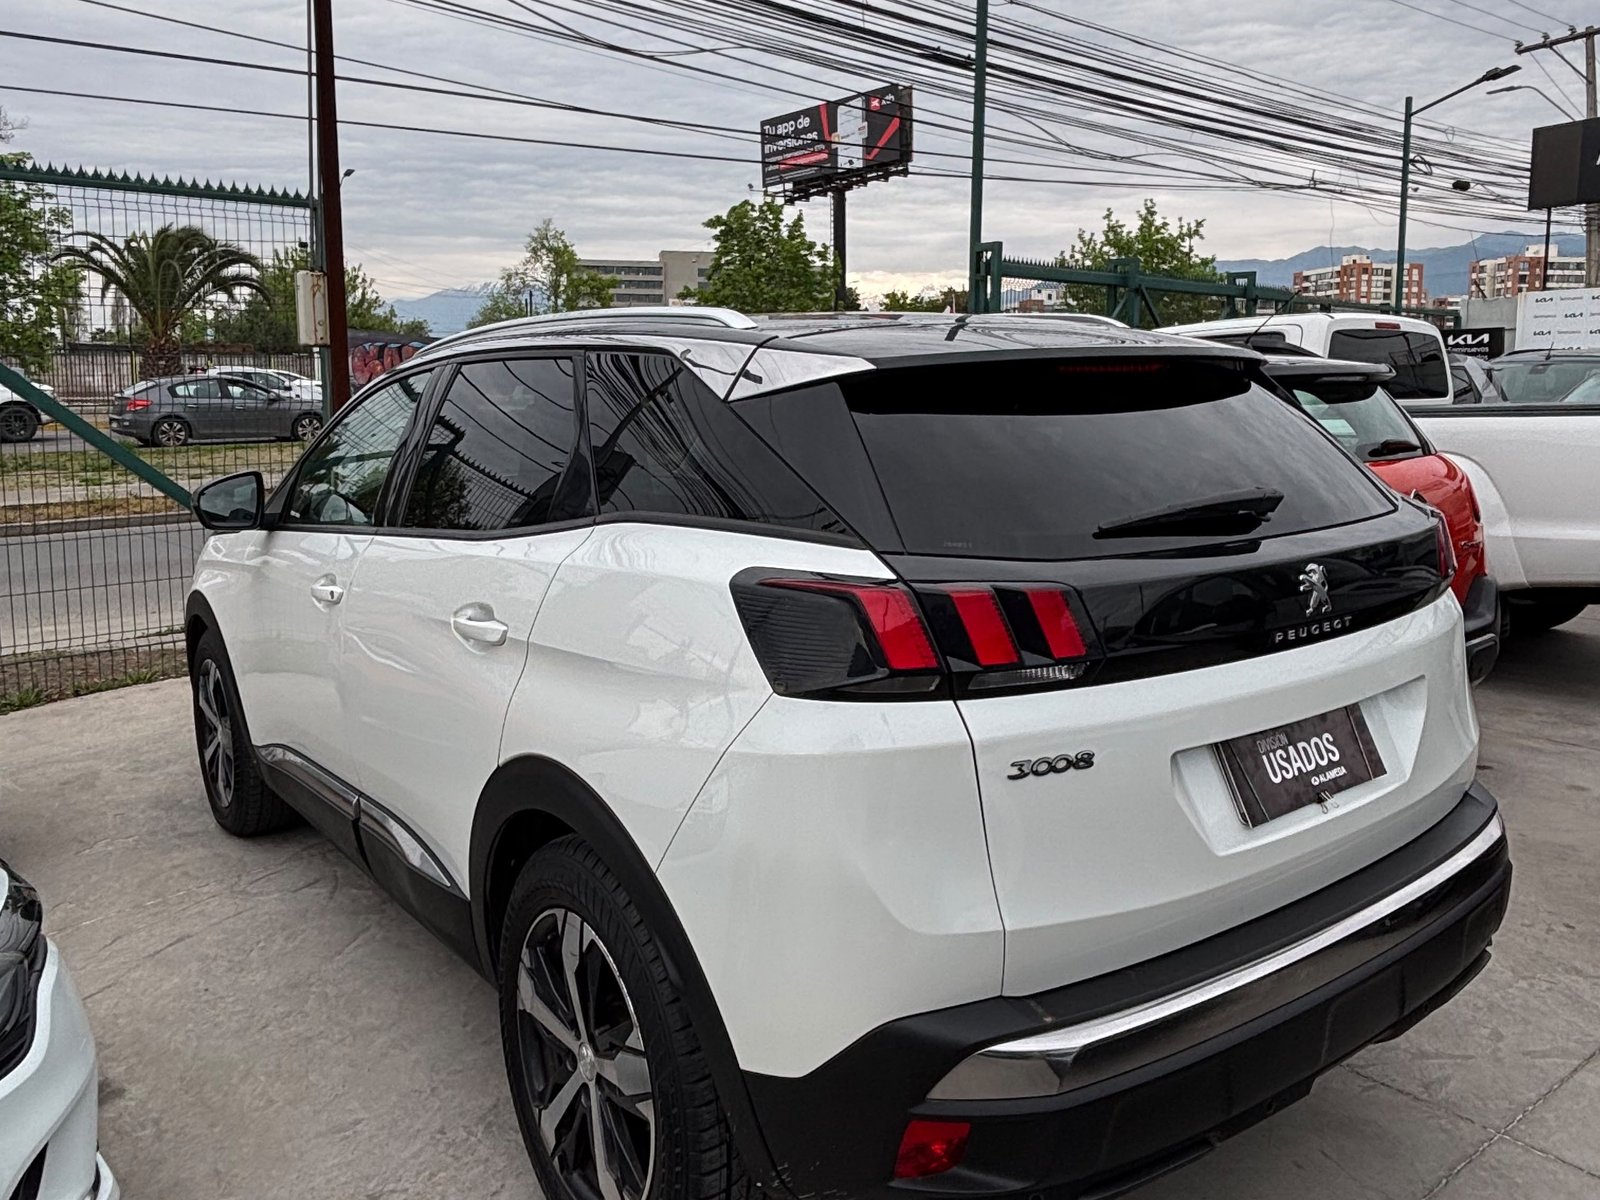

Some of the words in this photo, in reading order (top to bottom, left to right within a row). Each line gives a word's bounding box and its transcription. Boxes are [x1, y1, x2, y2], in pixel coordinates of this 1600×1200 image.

[763, 125, 775, 134] Tu
[776, 120, 795, 136] app
[797, 115, 810, 129] de
[1447, 333, 1489, 345] KIA
[1275, 616, 1352, 643] PEUGEOT
[1007, 750, 1095, 780] 3008
[1262, 732, 1340, 784] USADOS
[1319, 765, 1347, 783] ALAMEDA
